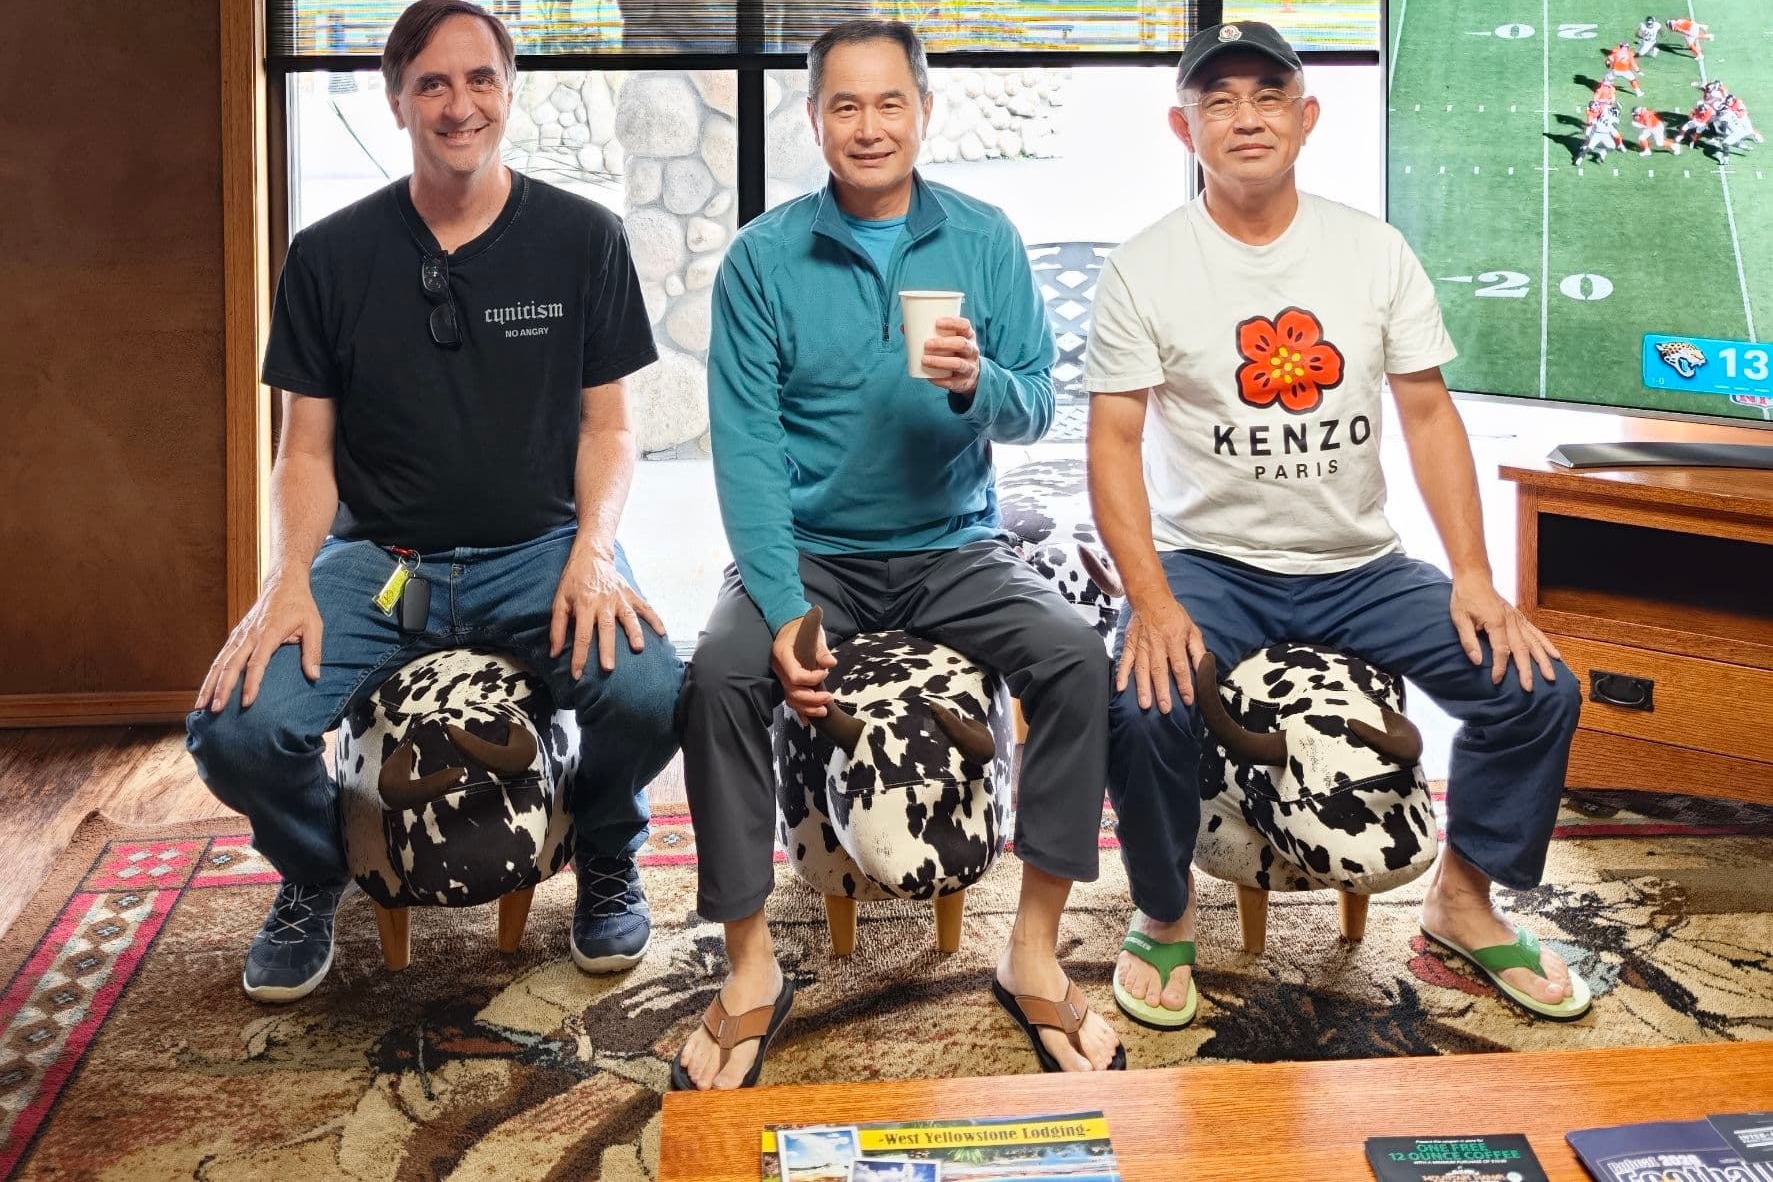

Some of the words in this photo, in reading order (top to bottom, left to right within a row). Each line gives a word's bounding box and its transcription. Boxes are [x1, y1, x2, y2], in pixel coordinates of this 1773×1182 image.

[485, 300, 563, 325] cynicism
[505, 329, 518, 338] NO
[520, 327, 549, 337] ANGRY
[1718, 347, 1769, 381] 13
[1213, 415, 1371, 456] KENZO
[1255, 459, 1338, 480] PARIS
[924, 1129, 1017, 1144] Yellowstone
[1388, 1152, 1406, 1161] 12
[1408, 1151, 1460, 1161] OUNCE
[1463, 1150, 1521, 1160] COFFEE
[1416, 1144, 1448, 1153] ONE
[1451, 1143, 1489, 1152] FREE
